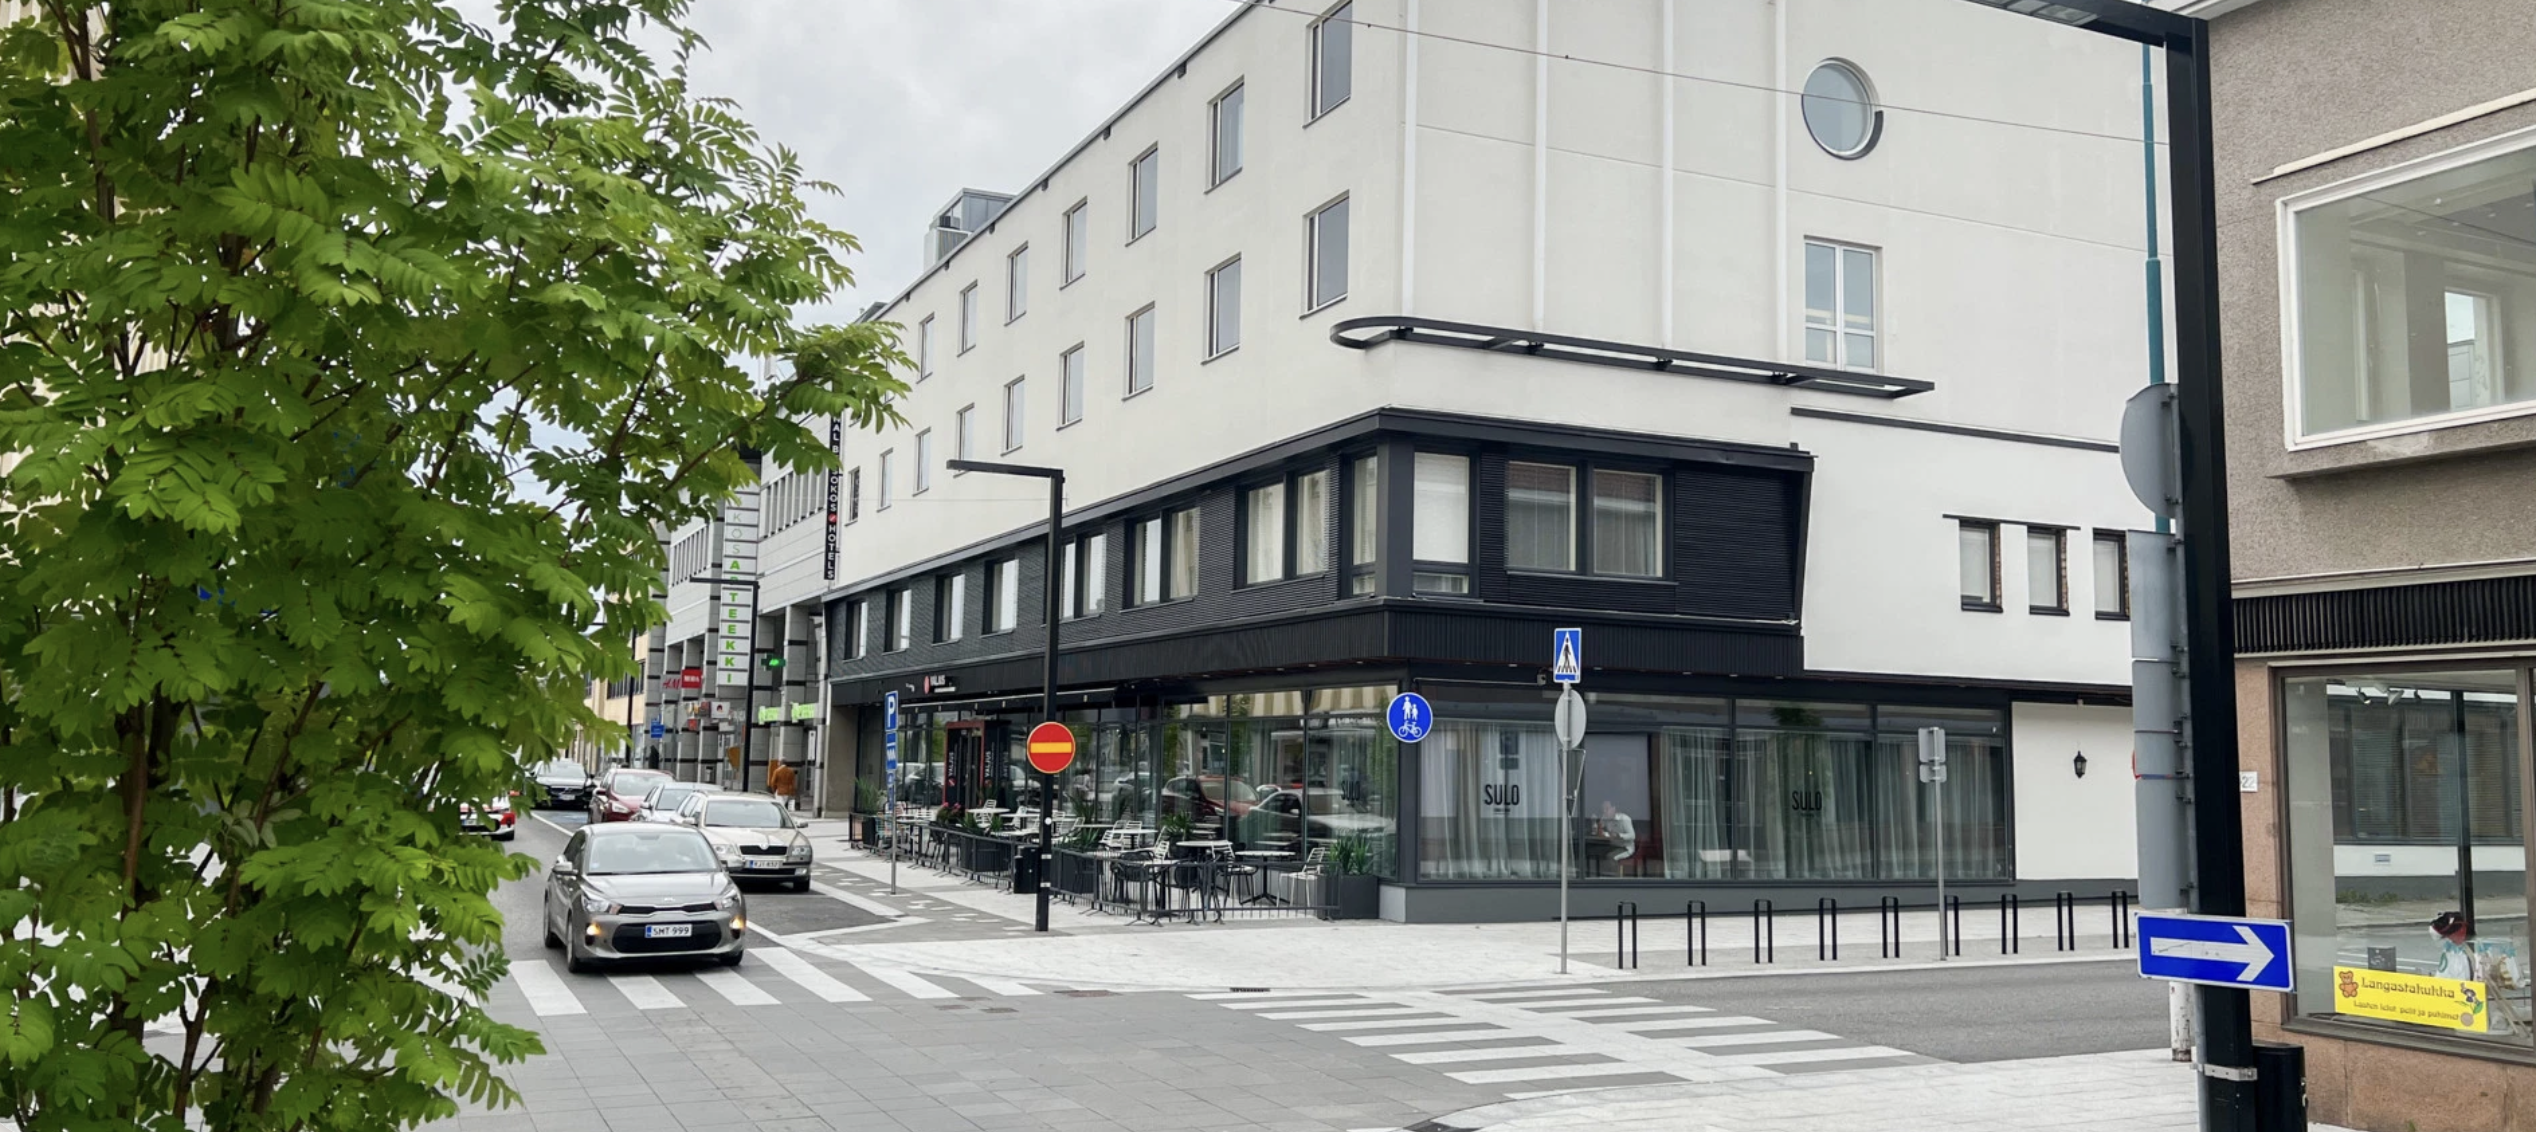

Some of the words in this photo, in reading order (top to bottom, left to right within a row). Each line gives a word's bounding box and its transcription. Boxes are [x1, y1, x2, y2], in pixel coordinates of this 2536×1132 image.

[826, 524, 837, 579] HOTELS
[887, 695, 896, 729] P
[1484, 784, 1520, 806] SULO
[1791, 790, 1823, 811] SULO
